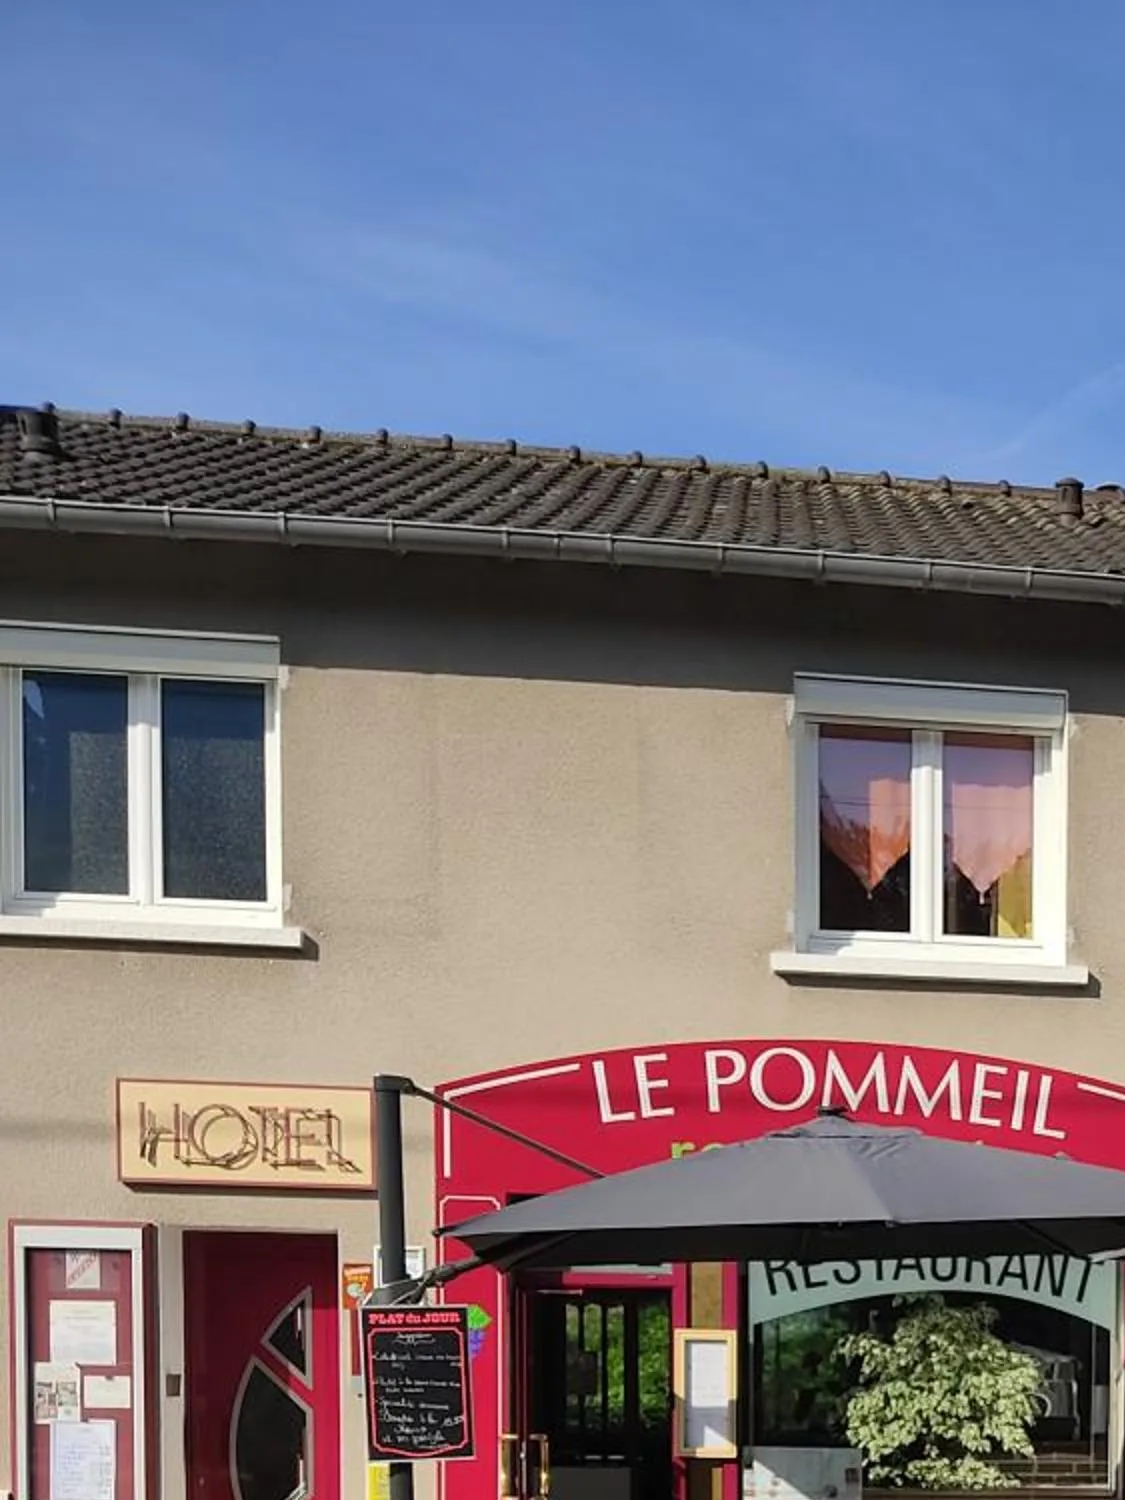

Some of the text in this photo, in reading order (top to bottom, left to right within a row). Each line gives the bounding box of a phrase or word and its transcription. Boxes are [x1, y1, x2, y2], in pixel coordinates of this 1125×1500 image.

[592, 1046, 1066, 1140] LE POMMEIL
[138, 1101, 363, 1174] HOTEL
[368, 1311, 461, 1325] PLAT du JOUR
